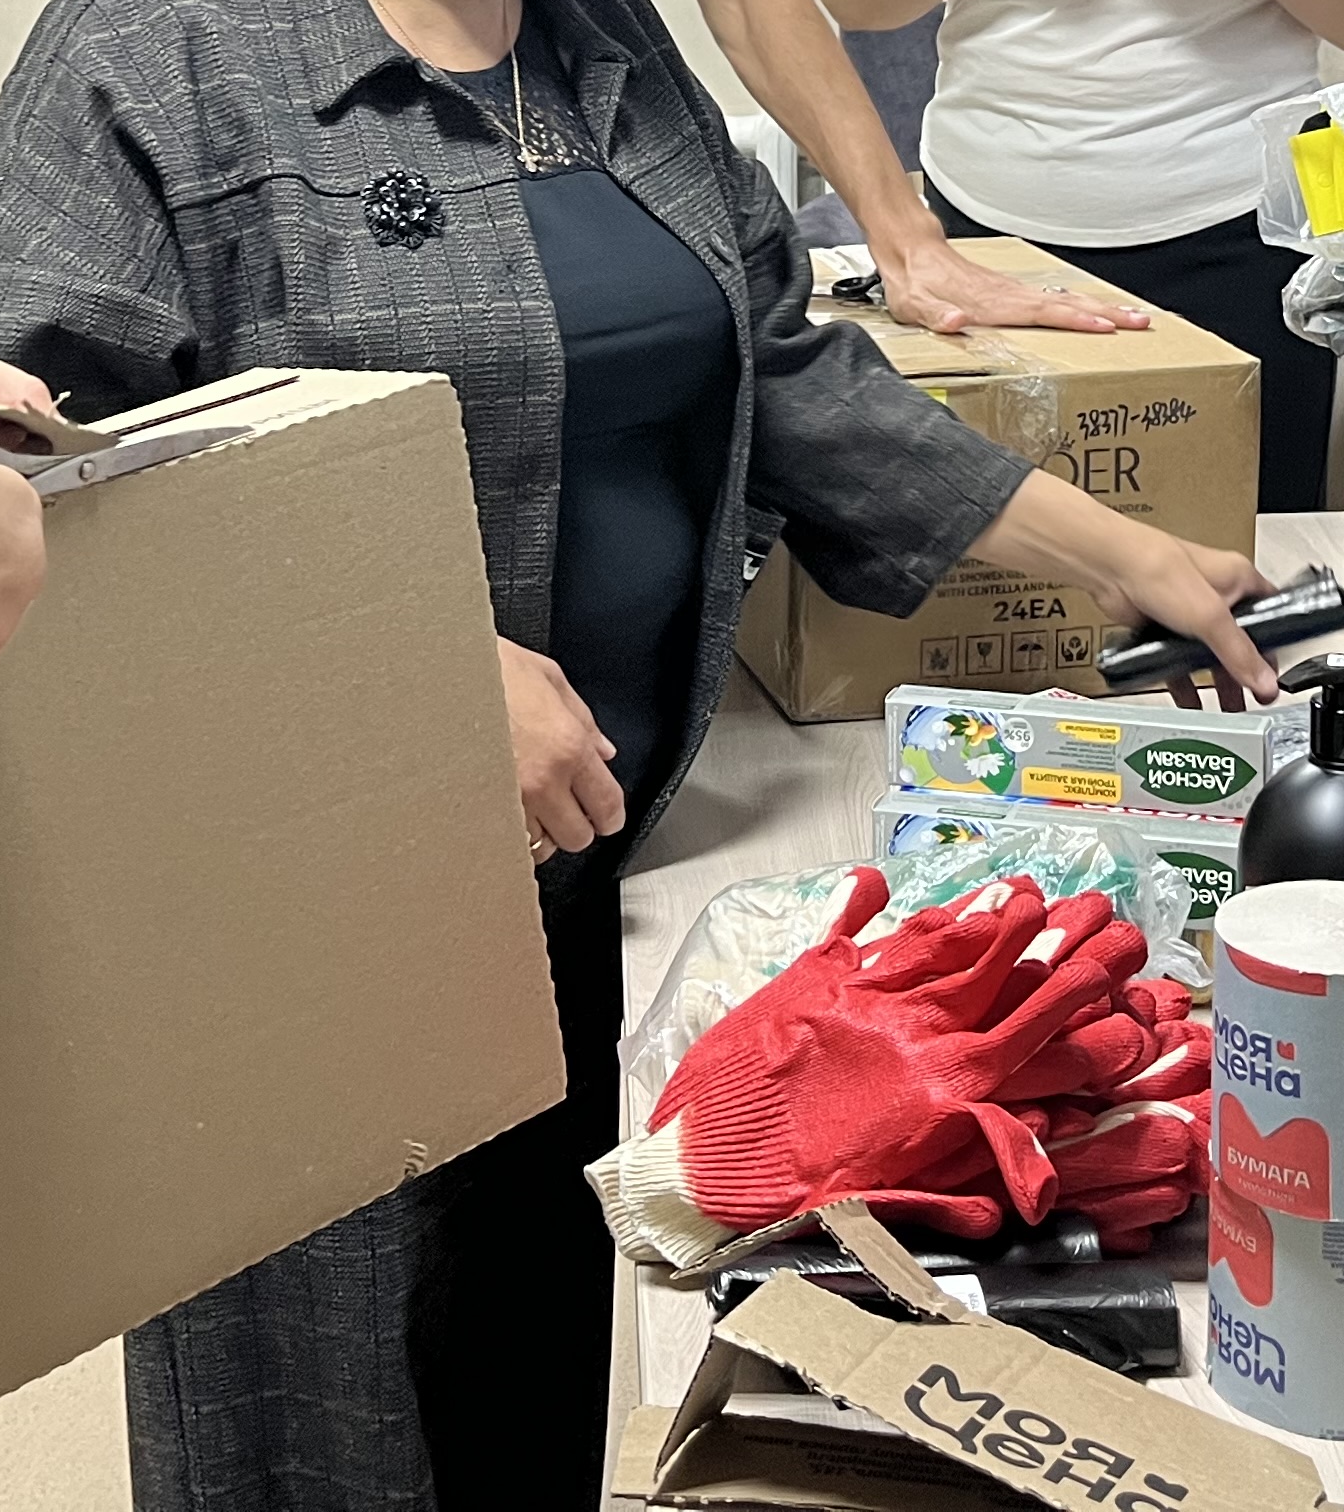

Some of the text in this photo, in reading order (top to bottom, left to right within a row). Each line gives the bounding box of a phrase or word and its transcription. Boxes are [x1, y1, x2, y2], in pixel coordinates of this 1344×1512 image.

[993, 598, 1067, 622] 24EA
[1146, 749, 1236, 773] Бальзам
[1063, 784, 1117, 798] КОМПЛЕКС
[1147, 768, 1231, 795] Лесной
[1177, 867, 1233, 891] Баль
[1191, 887, 1232, 908] Лес
[1227, 1146, 1311, 1189] БУМАГА
